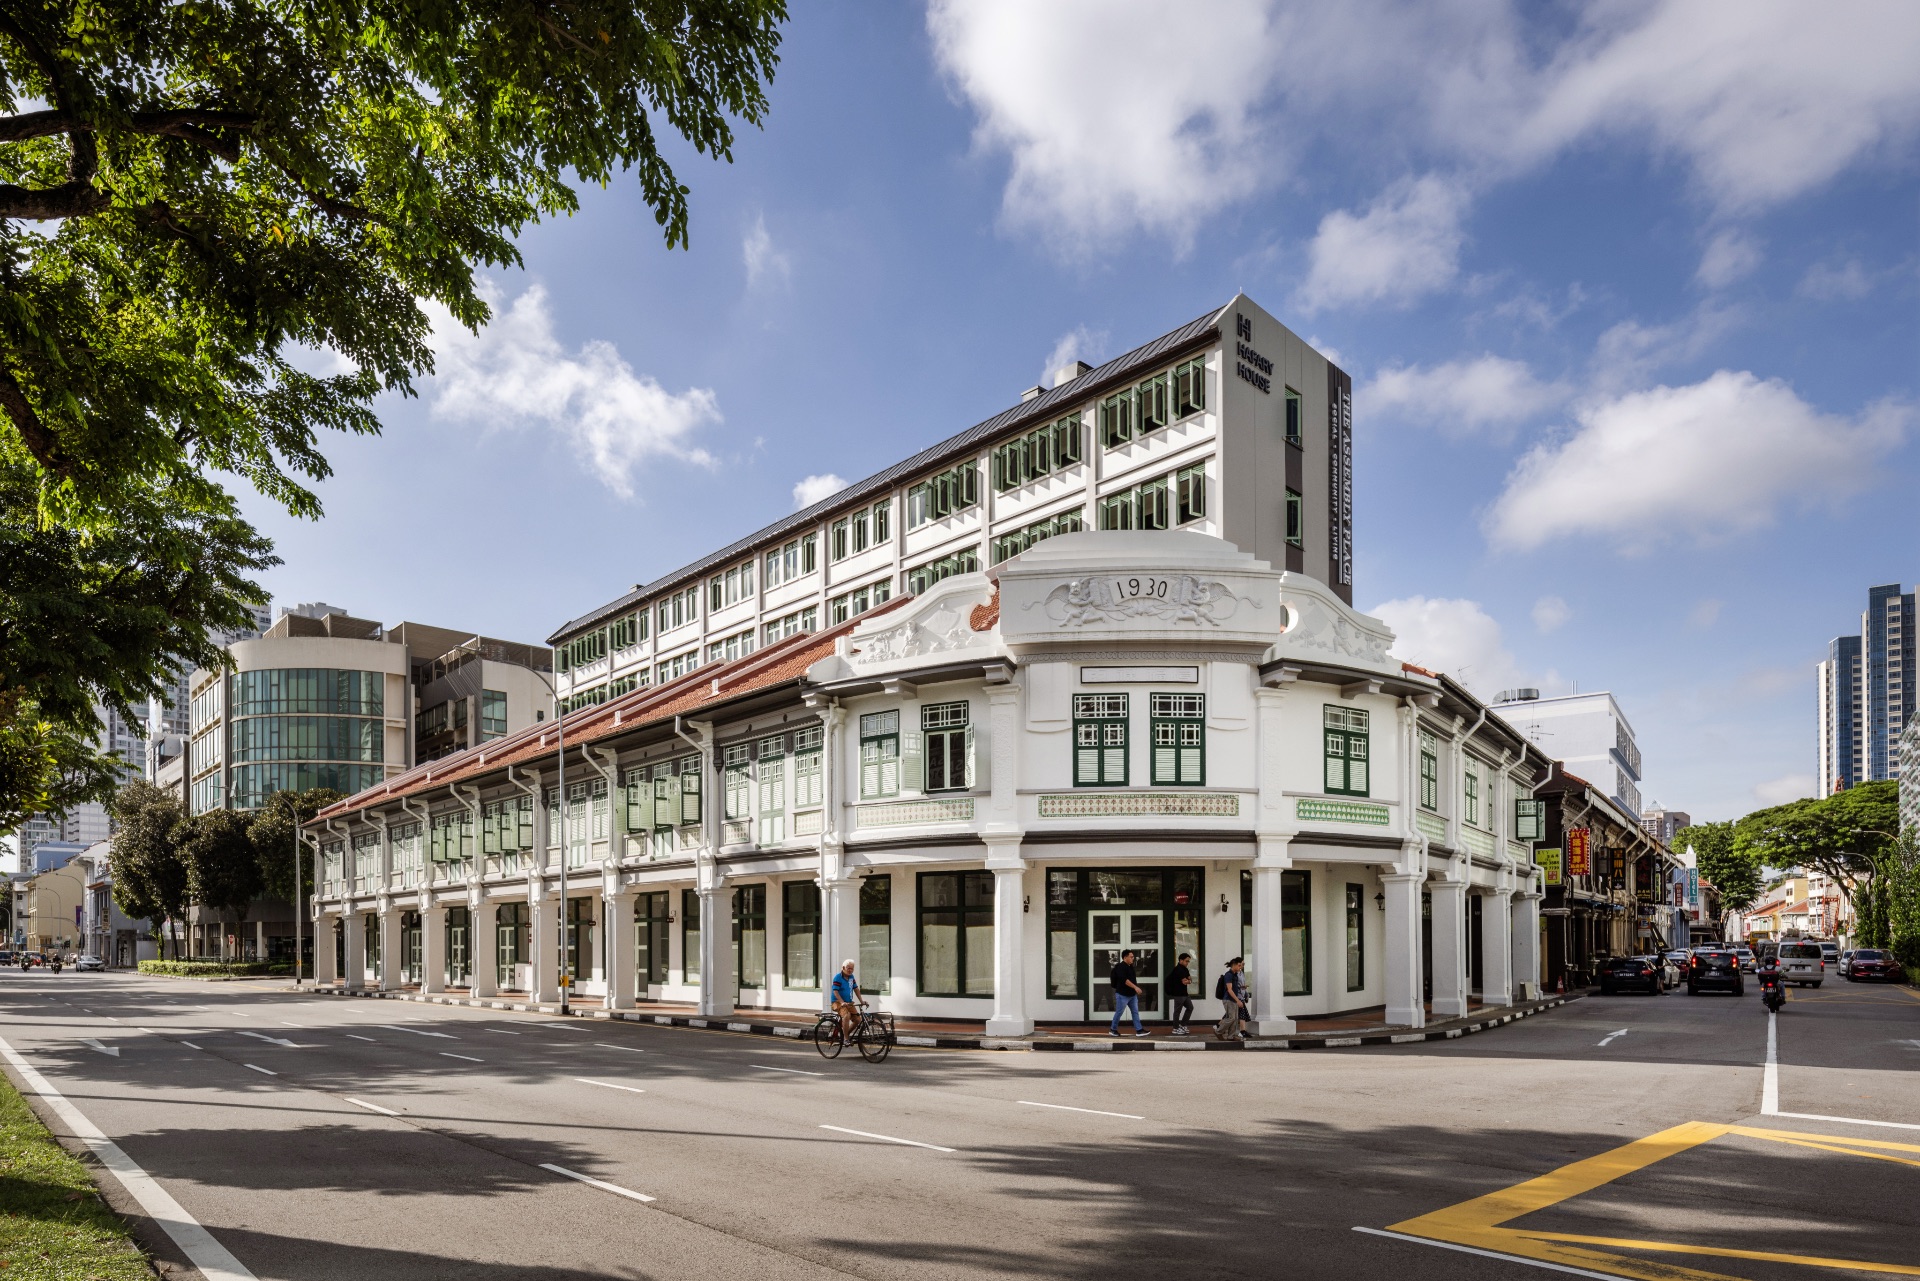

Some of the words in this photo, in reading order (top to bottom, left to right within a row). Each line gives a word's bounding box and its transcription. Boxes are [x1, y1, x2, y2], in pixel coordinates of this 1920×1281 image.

[1237, 341, 1275, 376] HAFARY
[1237, 361, 1271, 394] HOUSE
[1342, 393, 1351, 429] THE
[1342, 430, 1351, 527] ASSEMBLY
[1331, 525, 1339, 560] LIVING
[1342, 527, 1352, 586] PLACE
[1117, 577, 1168, 599] 1930
